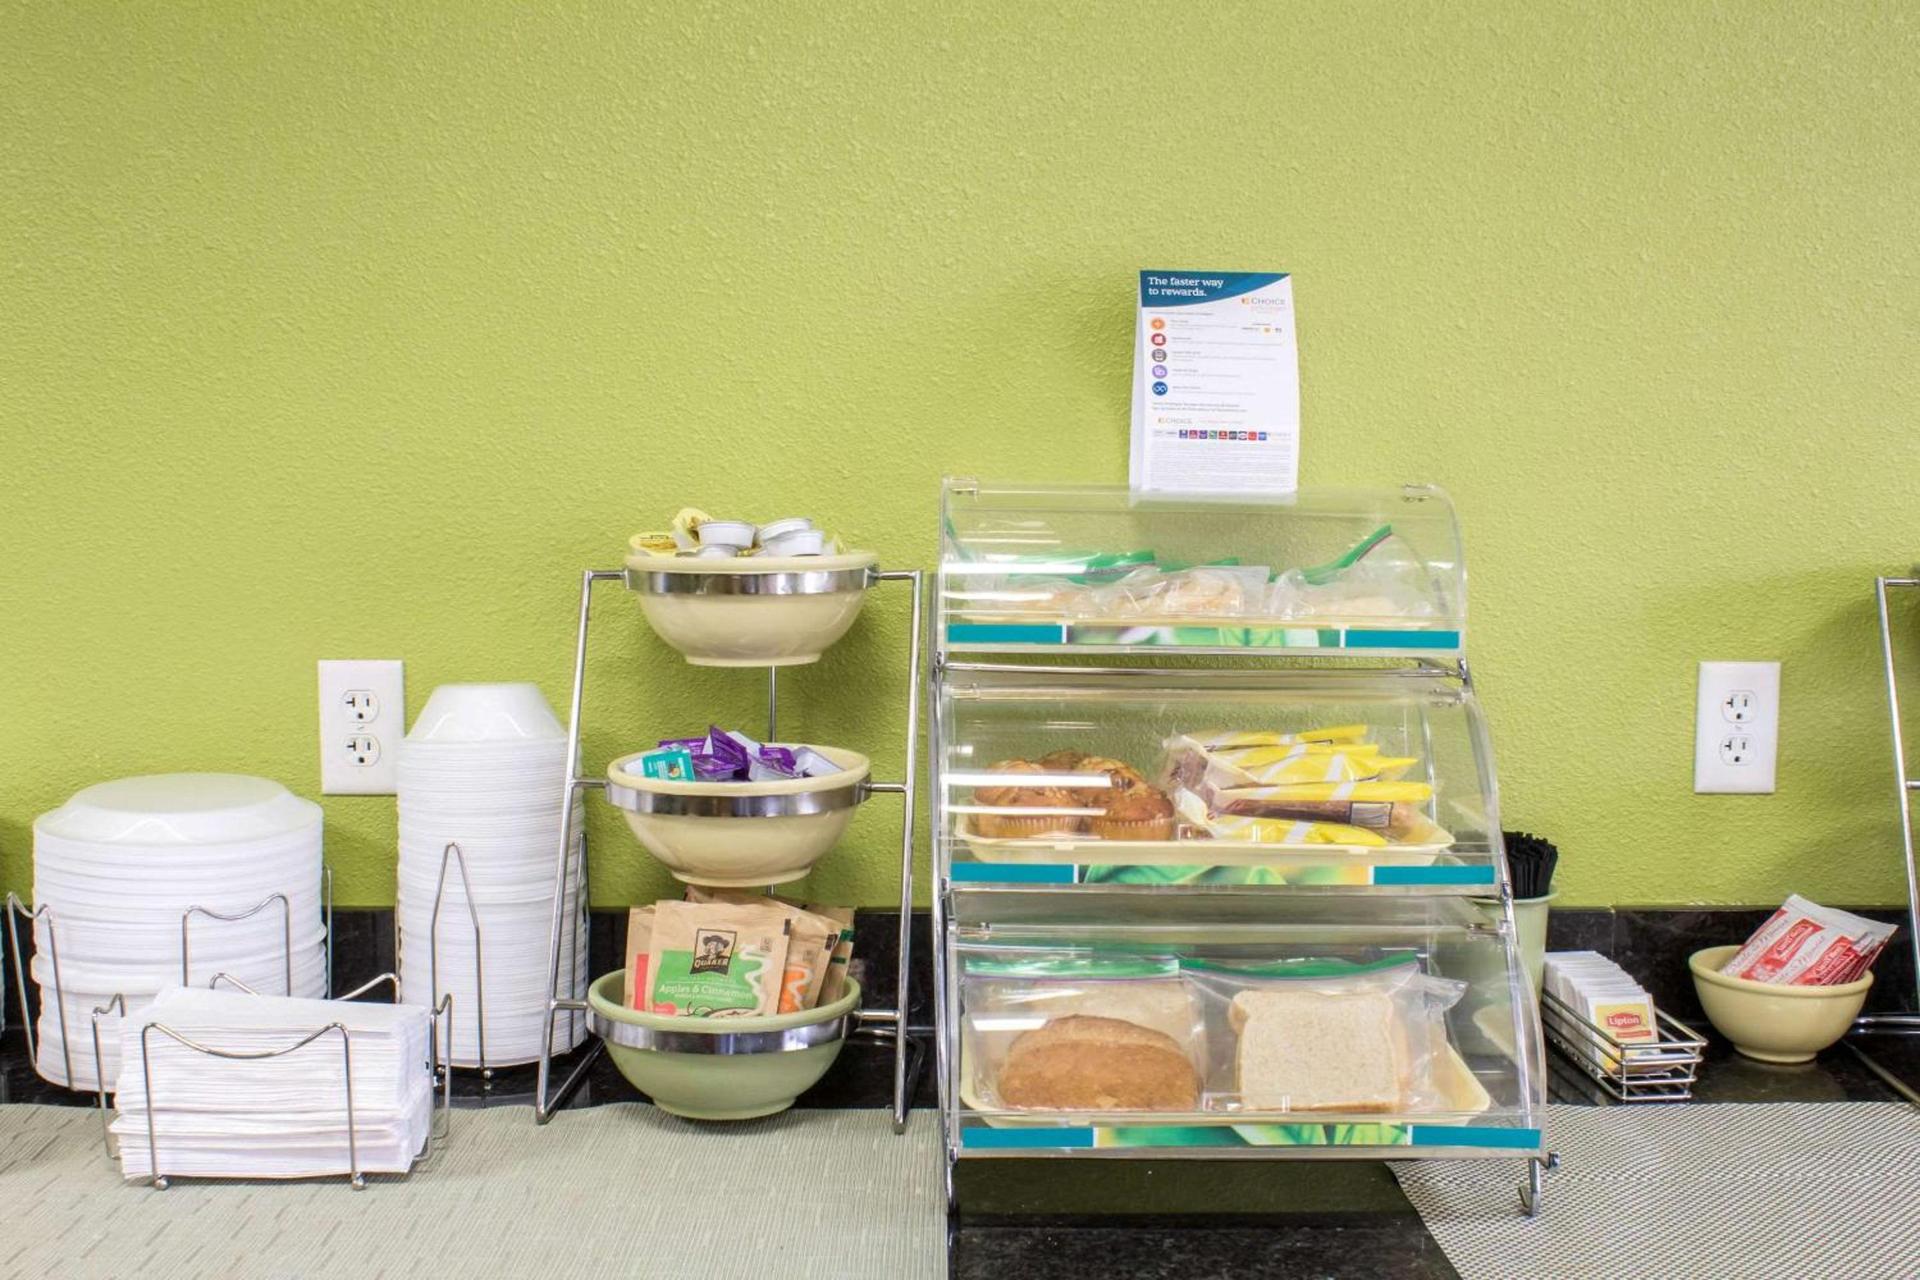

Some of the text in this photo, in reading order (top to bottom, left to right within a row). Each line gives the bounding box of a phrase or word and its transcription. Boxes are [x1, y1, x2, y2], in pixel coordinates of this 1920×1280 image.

[1148, 277, 1224, 288] The faster way
[1148, 287, 1207, 297] to rewards.
[1251, 297, 1286, 305] CHOICE
[694, 958, 728, 969] QUAKER
[659, 984, 690, 995] Apples
[692, 985, 700, 994] &
[701, 985, 753, 1000] Cinnamon
[1609, 1015, 1640, 1026] Lipton
